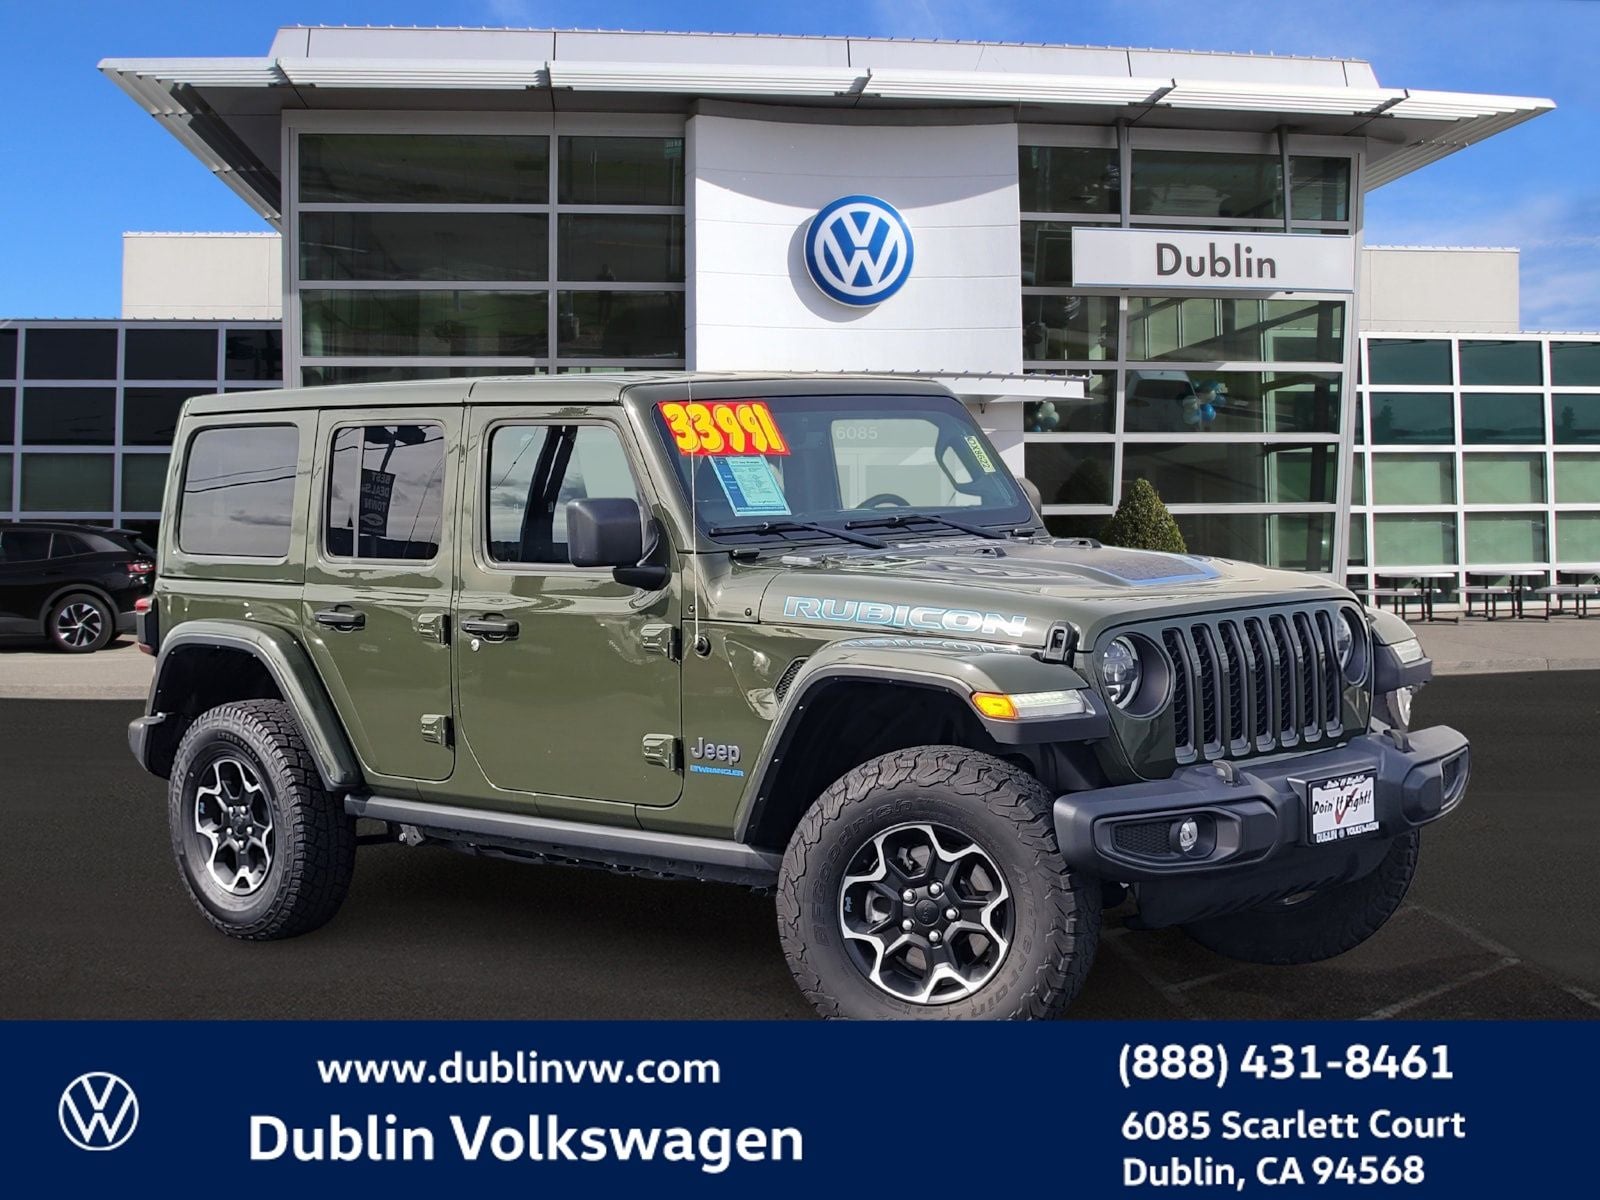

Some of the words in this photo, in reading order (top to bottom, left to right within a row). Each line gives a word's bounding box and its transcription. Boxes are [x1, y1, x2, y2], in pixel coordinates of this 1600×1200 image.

[1156, 242, 1276, 279] Dublin
[662, 403, 786, 453] 33991
[836, 425, 878, 440] 6085
[783, 596, 1028, 637] RUBICON
[690, 736, 741, 766] Jeep
